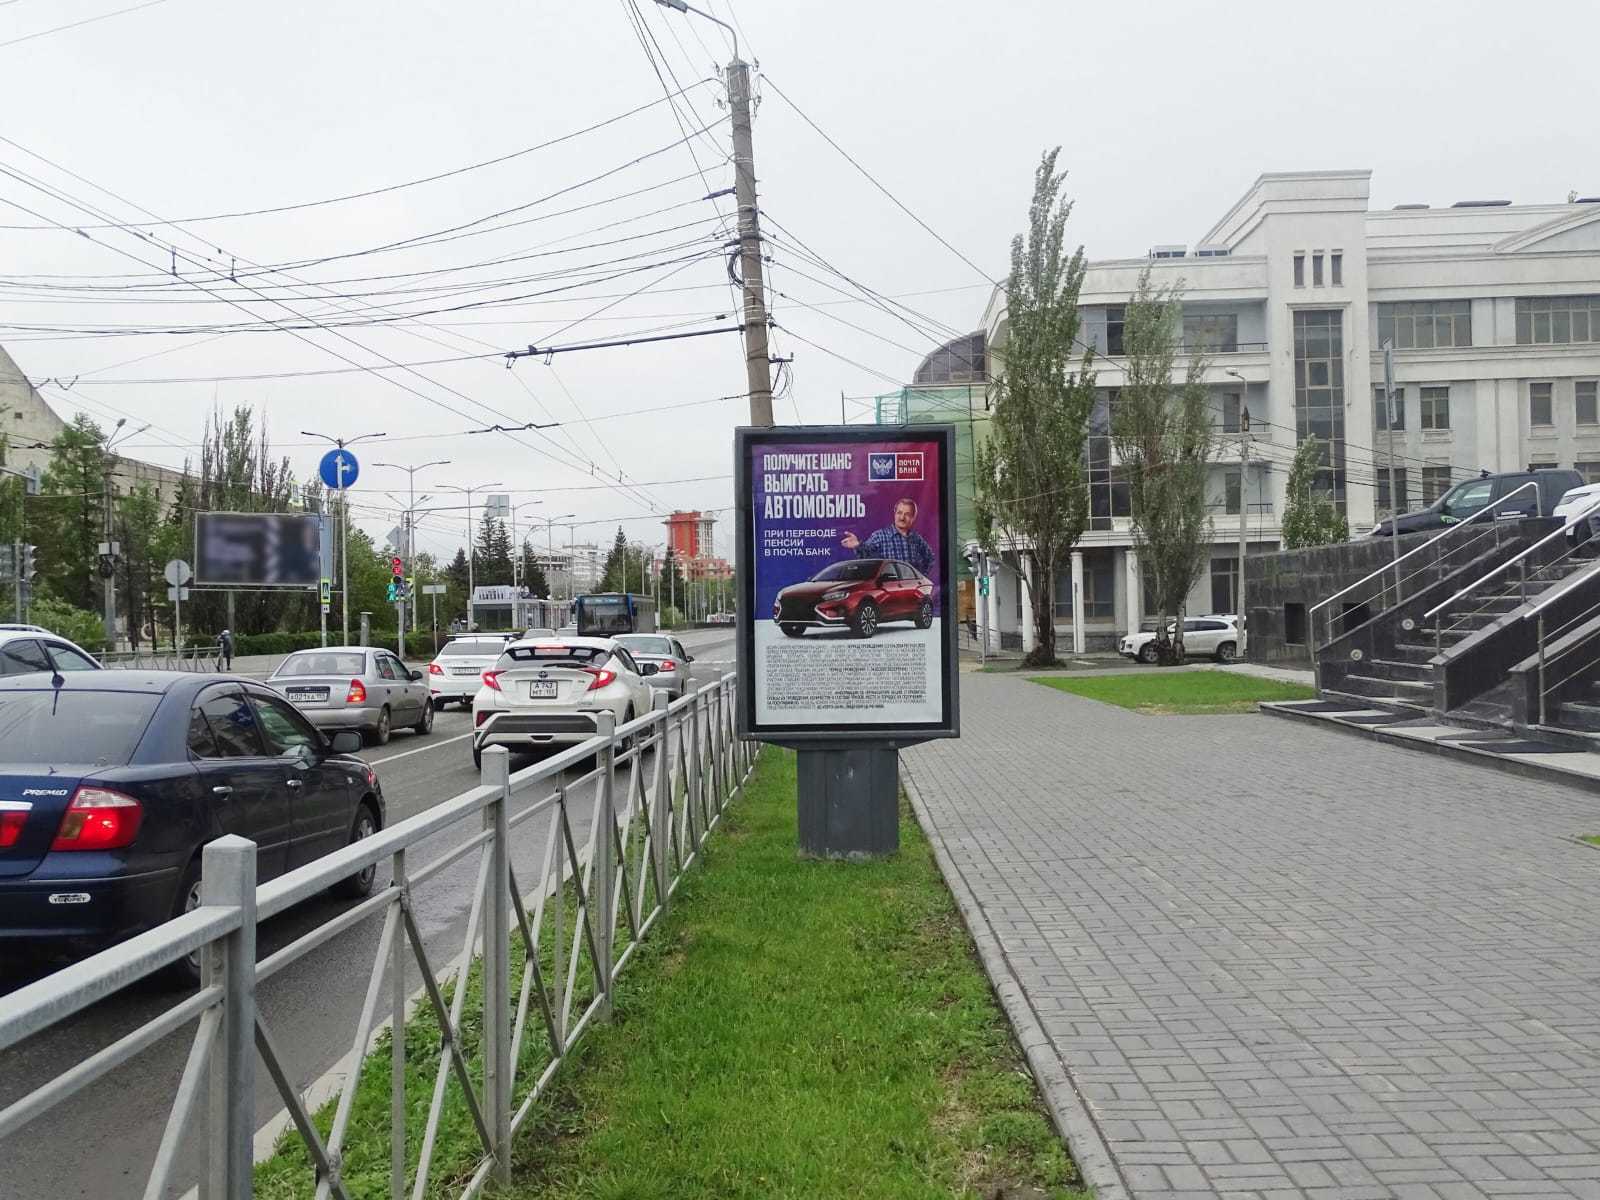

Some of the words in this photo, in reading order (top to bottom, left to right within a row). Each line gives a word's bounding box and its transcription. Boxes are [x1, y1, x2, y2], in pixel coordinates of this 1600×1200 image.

[764, 454, 818, 470] ПОЛУЧИТЕ
[820, 453, 852, 470] ШАНС
[764, 473, 829, 492] ВЫИГРАТЬ
[764, 494, 866, 519] АВТОМОБИЛЬ
[764, 529, 784, 539] ПРИ
[786, 529, 837, 538] ПЕРЕВОДЕ
[764, 538, 804, 548] ПЕНСИИ
[764, 548, 771, 557] В
[773, 548, 804, 557] ПОЧТА
[806, 547, 831, 556] БАНК
[22, 788, 68, 797] PREMIO
